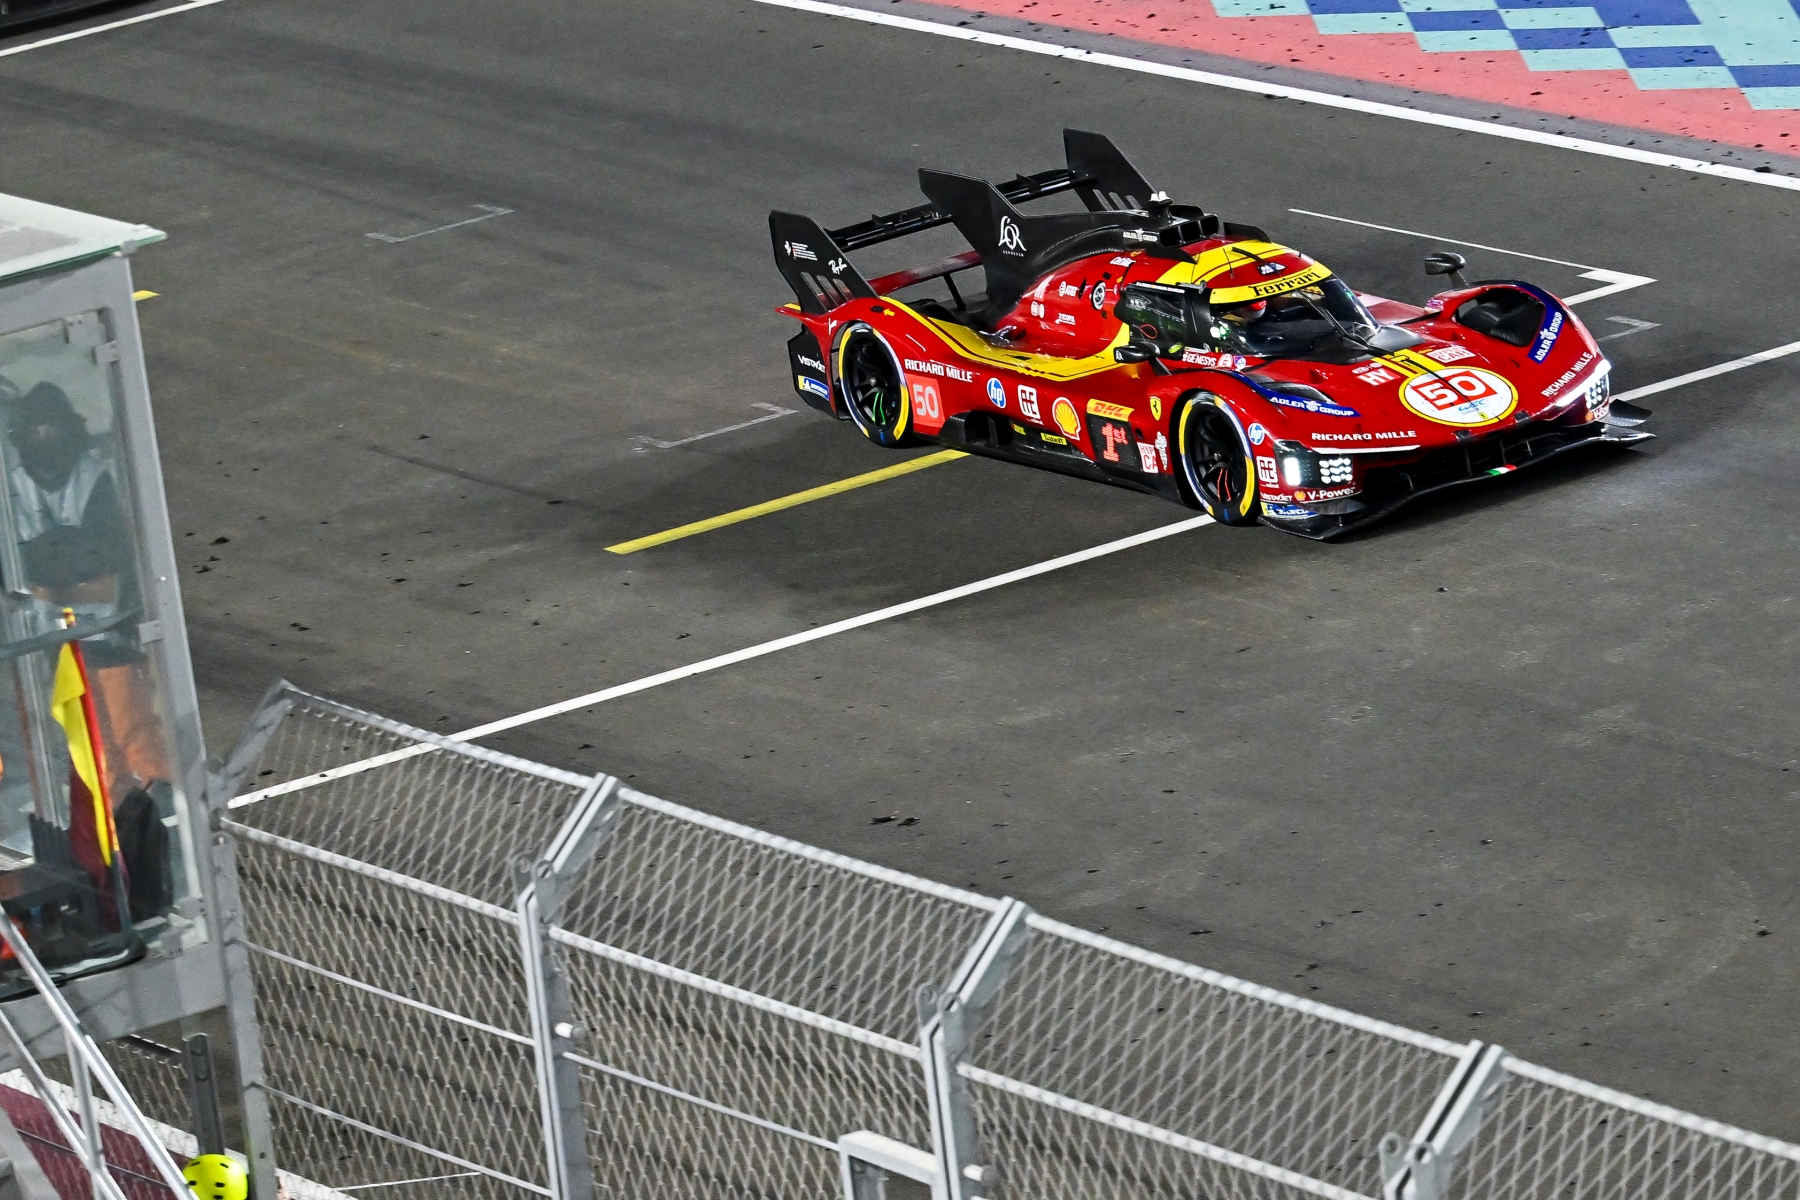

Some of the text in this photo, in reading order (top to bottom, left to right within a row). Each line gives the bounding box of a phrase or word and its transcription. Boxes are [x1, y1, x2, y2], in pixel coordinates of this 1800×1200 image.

[1248, 268, 1322, 297] Ferrari
[1534, 311, 1563, 361] ADLER GROUP
[904, 359, 974, 383] RICHARD MILLE
[1187, 353, 1217, 367] GENESYS
[1541, 351, 1594, 397] RICHARD MILLE
[913, 384, 939, 419] 50
[988, 379, 1004, 407] hp
[1417, 376, 1487, 407] 50
[1093, 402, 1124, 417] DHL
[1270, 396, 1355, 416] ADLER GROUP
[1250, 424, 1263, 444] hp
[1311, 430, 1417, 441] RICHARD MILLE
[1307, 488, 1355, 499] V-Power
